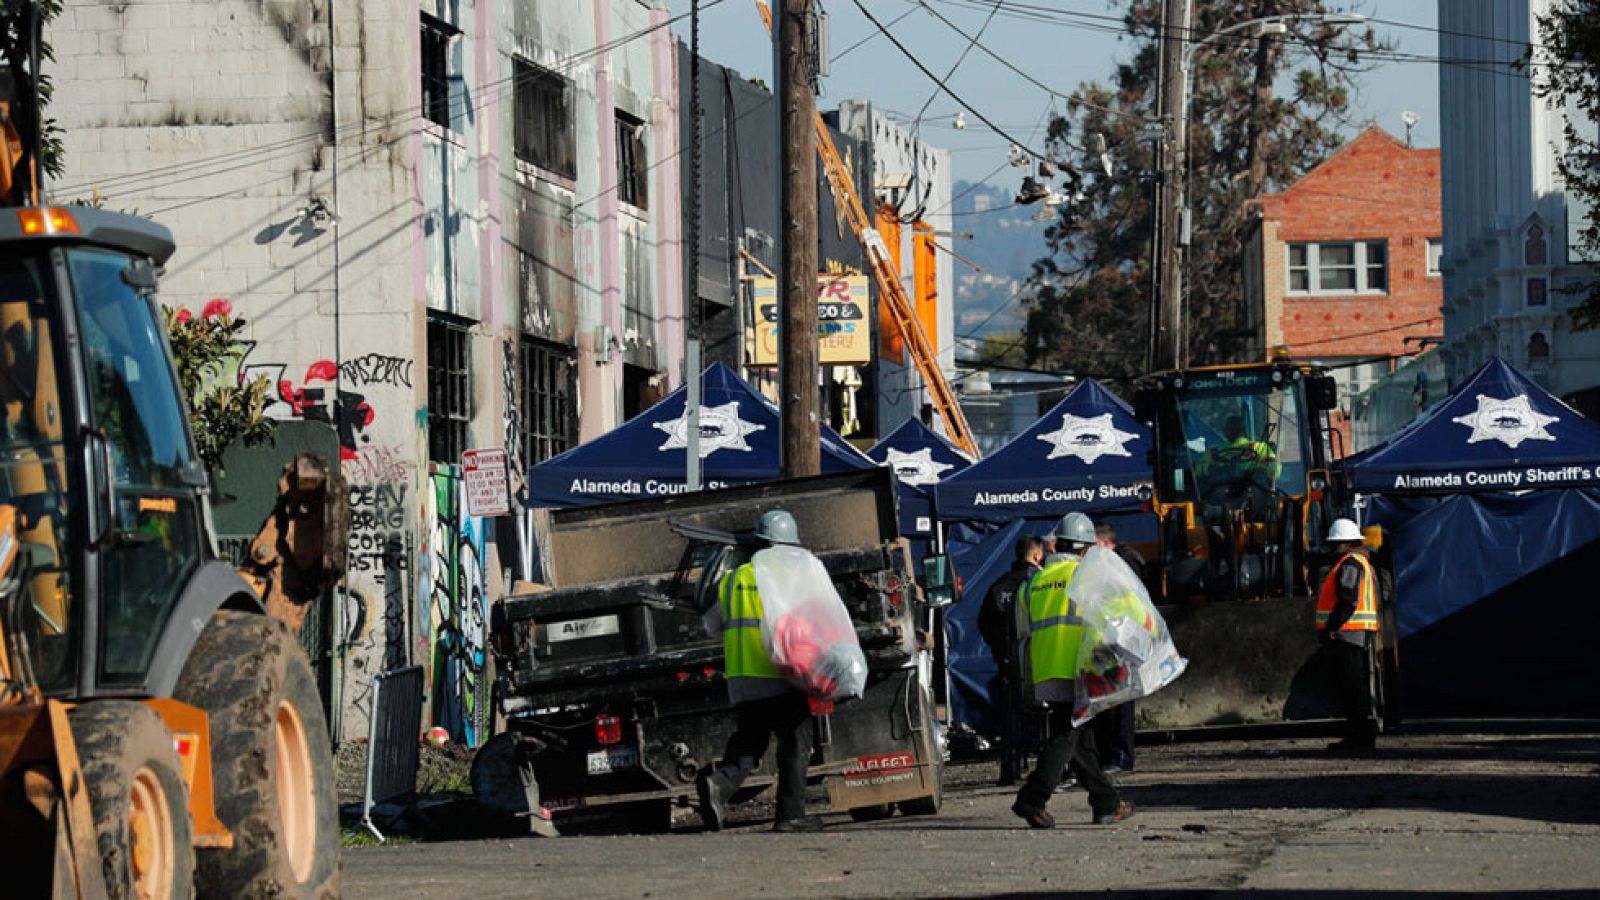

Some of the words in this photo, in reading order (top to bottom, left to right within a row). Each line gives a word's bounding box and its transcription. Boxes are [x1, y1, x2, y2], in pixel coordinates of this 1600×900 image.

[570, 478, 641, 494] Alameda
[1394, 474, 1462, 489] Alameda
[1465, 470, 1522, 485] County
[1526, 466, 1591, 482] Sheriff's
[974, 492, 1038, 506] Alameda
[1042, 487, 1095, 502] County
